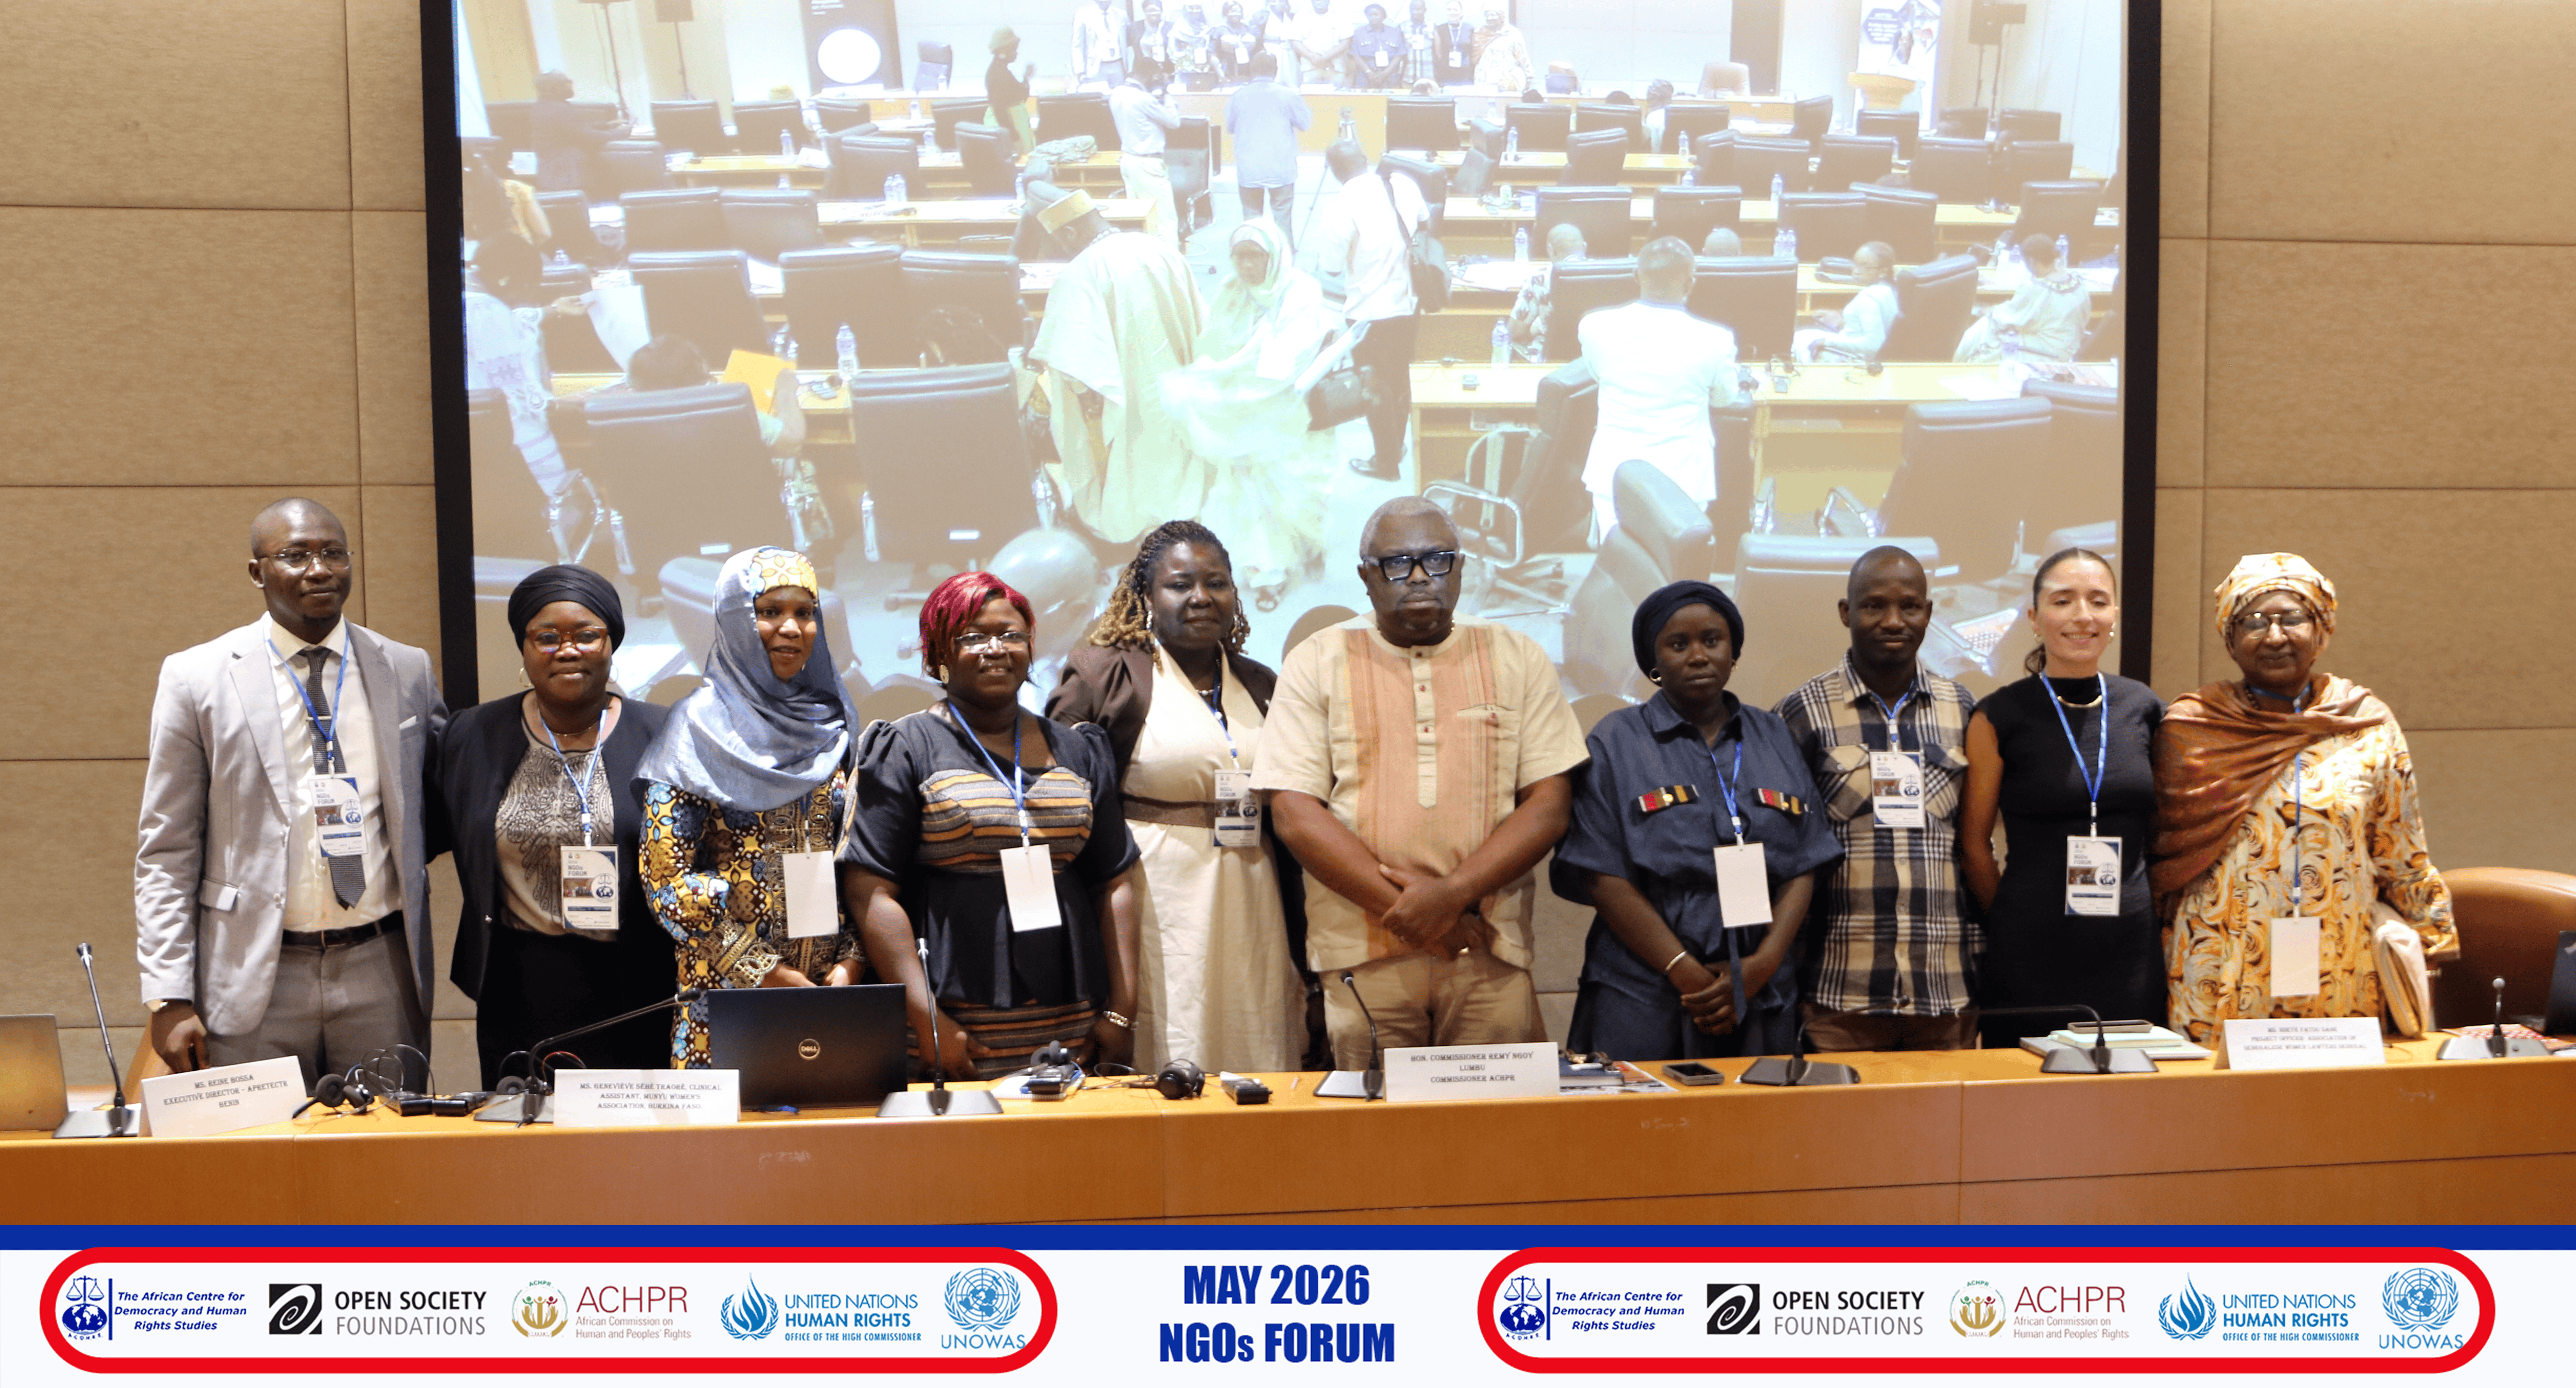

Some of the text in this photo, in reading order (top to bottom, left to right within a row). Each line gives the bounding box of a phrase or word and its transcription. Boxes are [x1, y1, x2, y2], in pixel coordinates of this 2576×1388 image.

[208, 1078, 229, 1087] REINE
[230, 1074, 254, 1083] BOSSA
[163, 1092, 204, 1105] EXECUTIVE
[206, 1088, 240, 1099] DIRECTOR
[247, 1080, 288, 1092] APRETECTR
[218, 1099, 240, 1108] BENIN
